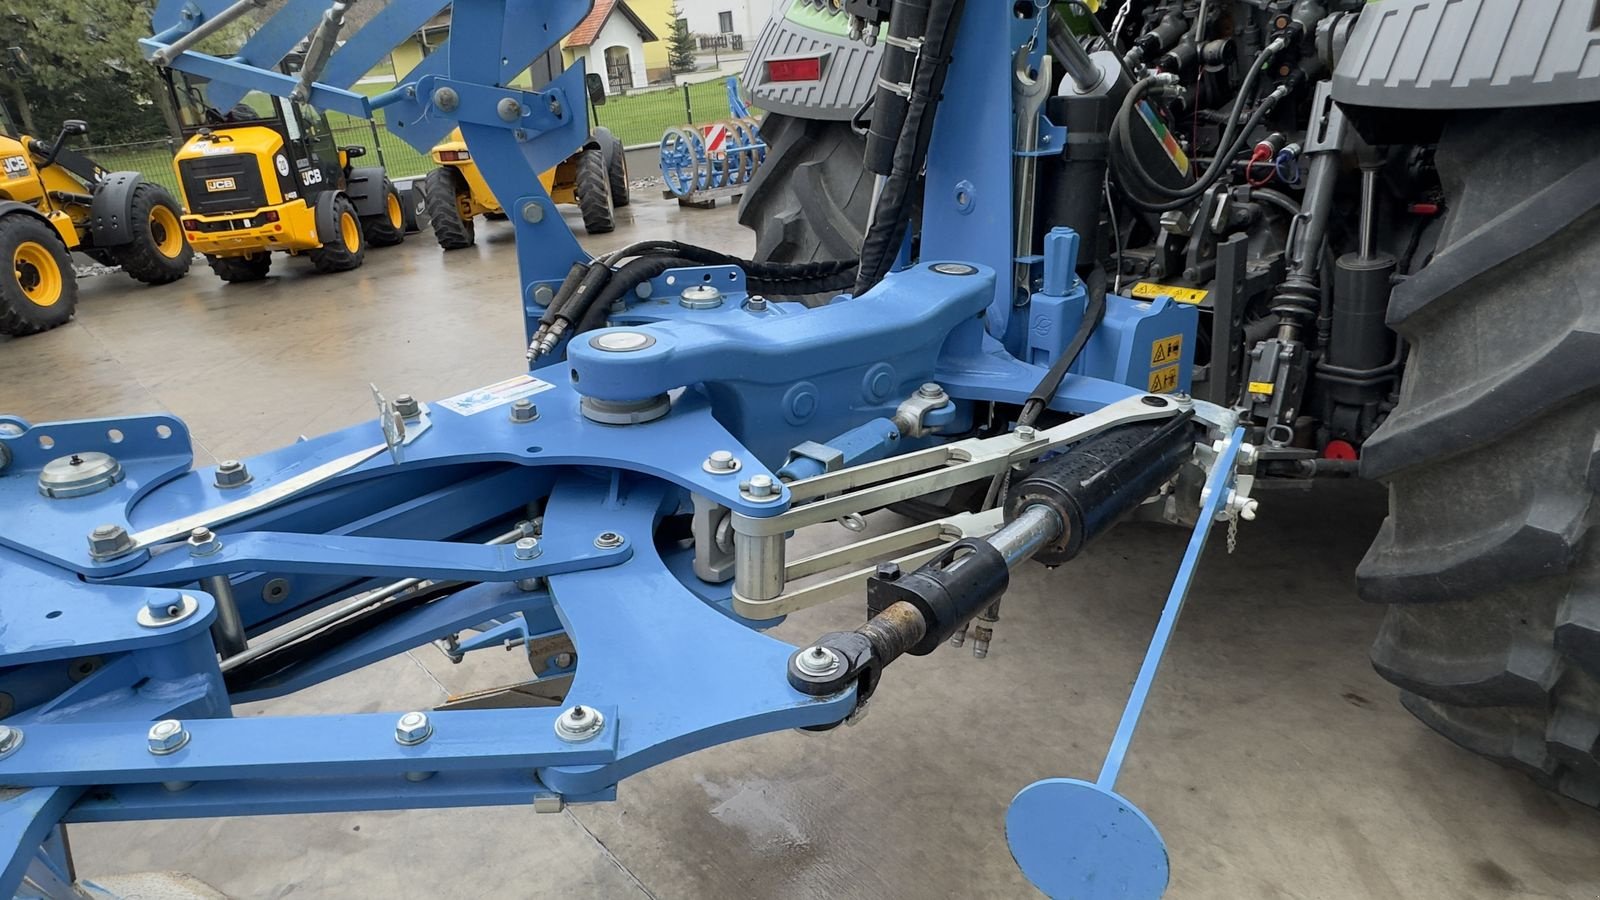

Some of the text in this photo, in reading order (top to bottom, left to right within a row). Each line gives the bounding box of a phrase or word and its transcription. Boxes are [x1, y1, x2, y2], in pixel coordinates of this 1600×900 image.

[3, 156, 28, 173] JCB
[208, 181, 234, 190] JCB
[302, 168, 322, 186] JCB
